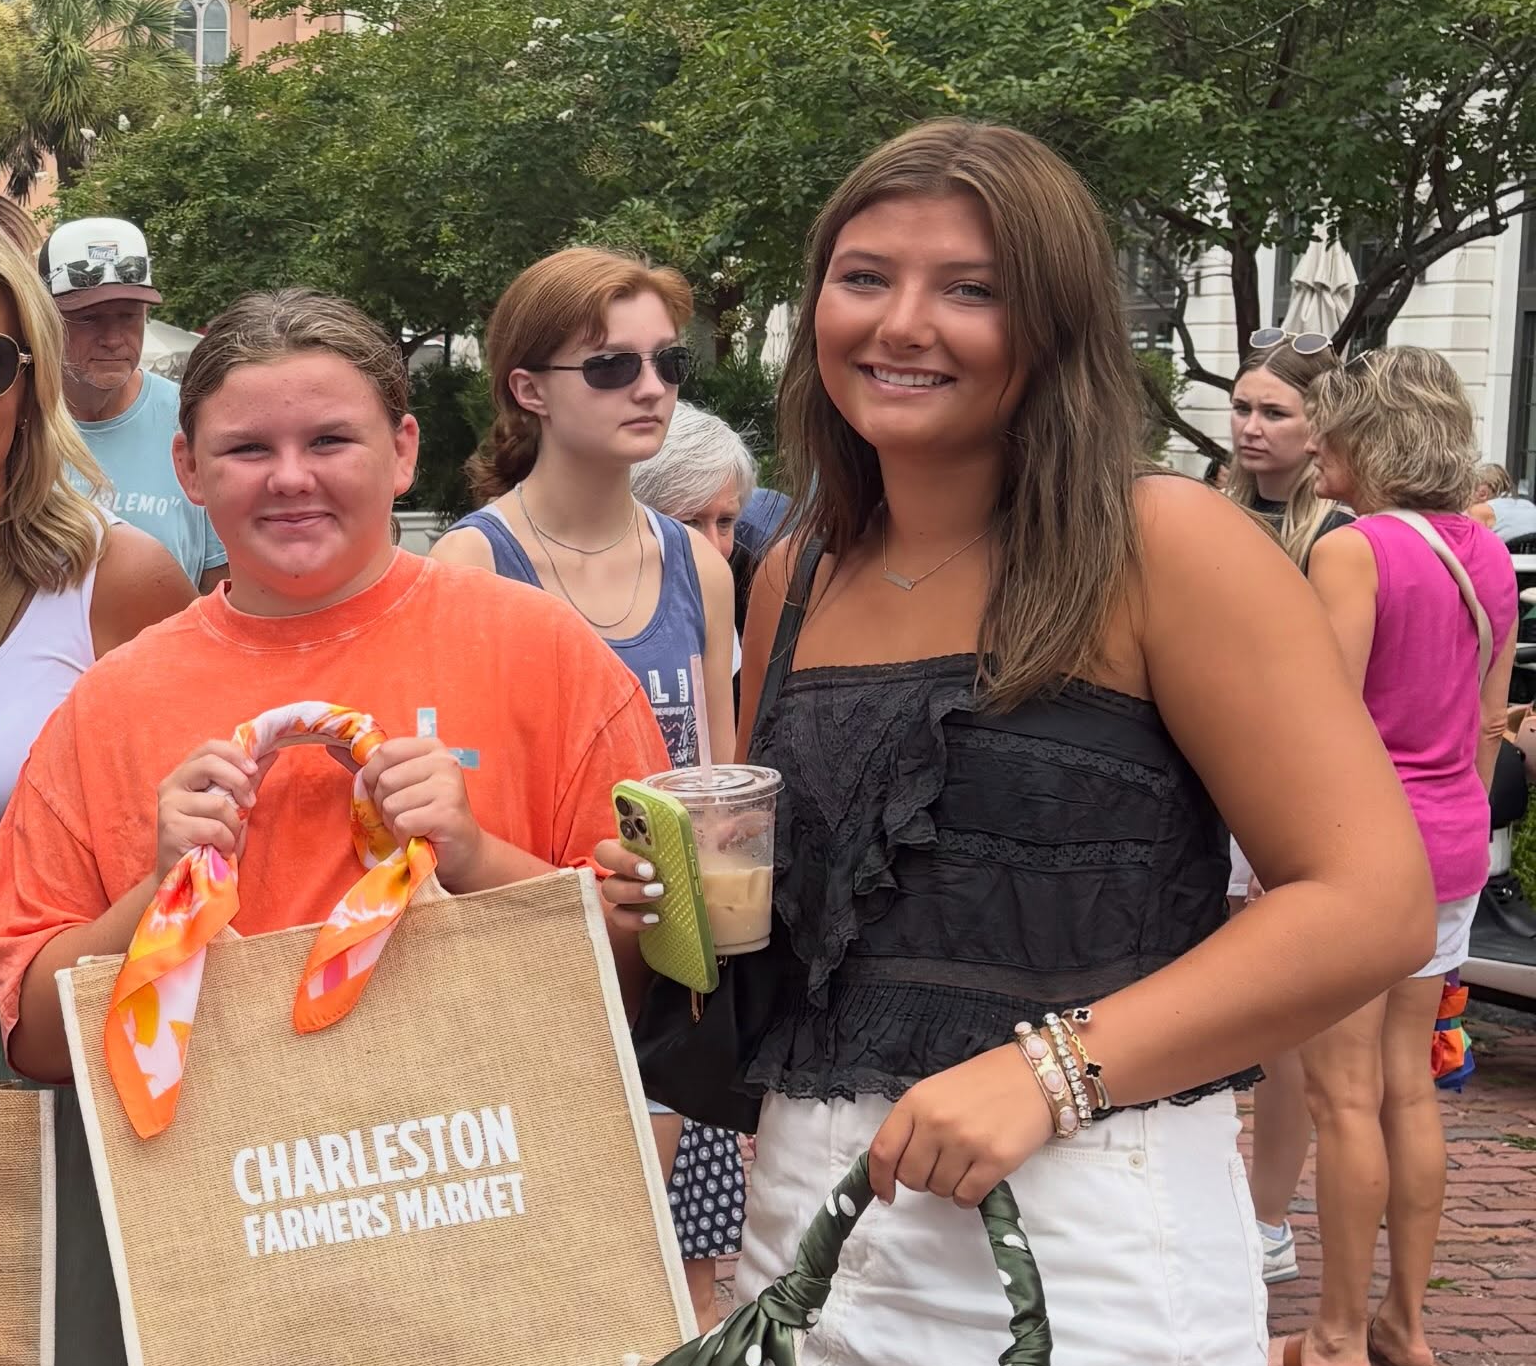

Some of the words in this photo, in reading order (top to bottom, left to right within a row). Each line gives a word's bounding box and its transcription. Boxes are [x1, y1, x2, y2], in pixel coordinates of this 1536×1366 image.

[232, 1105, 520, 1206] CHARLESTON
[243, 1194, 392, 1257] FARMERS
[395, 1172, 526, 1234] MARKET
